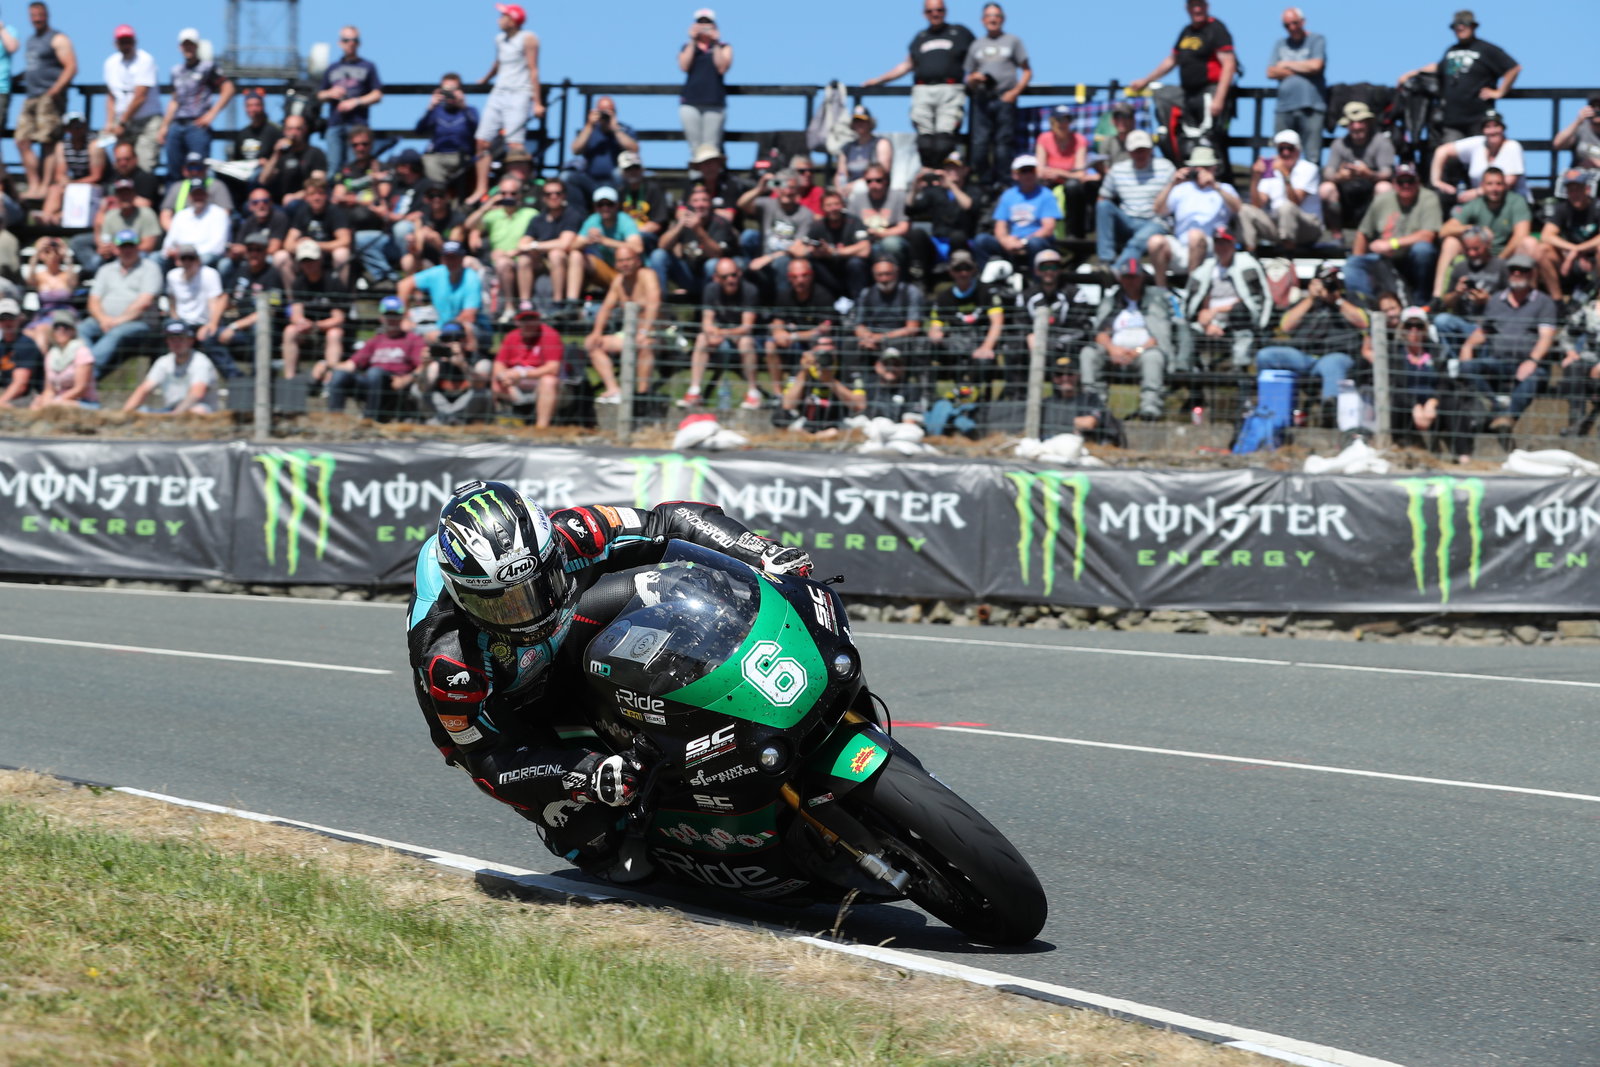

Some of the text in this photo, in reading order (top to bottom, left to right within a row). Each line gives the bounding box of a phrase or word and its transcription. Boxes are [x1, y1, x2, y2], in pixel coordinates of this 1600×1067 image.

[0, 466, 219, 511] MONSTER
[342, 473, 579, 519] MONER
[718, 478, 966, 529] MONSTER
[21, 515, 186, 536] ENERGY
[1099, 496, 1354, 541] MONSTER
[499, 558, 534, 581] Arai
[1137, 549, 1315, 567] ENERGY
[740, 640, 809, 707] 6
[685, 723, 735, 757] SC
[705, 764, 744, 783] SPRINT
